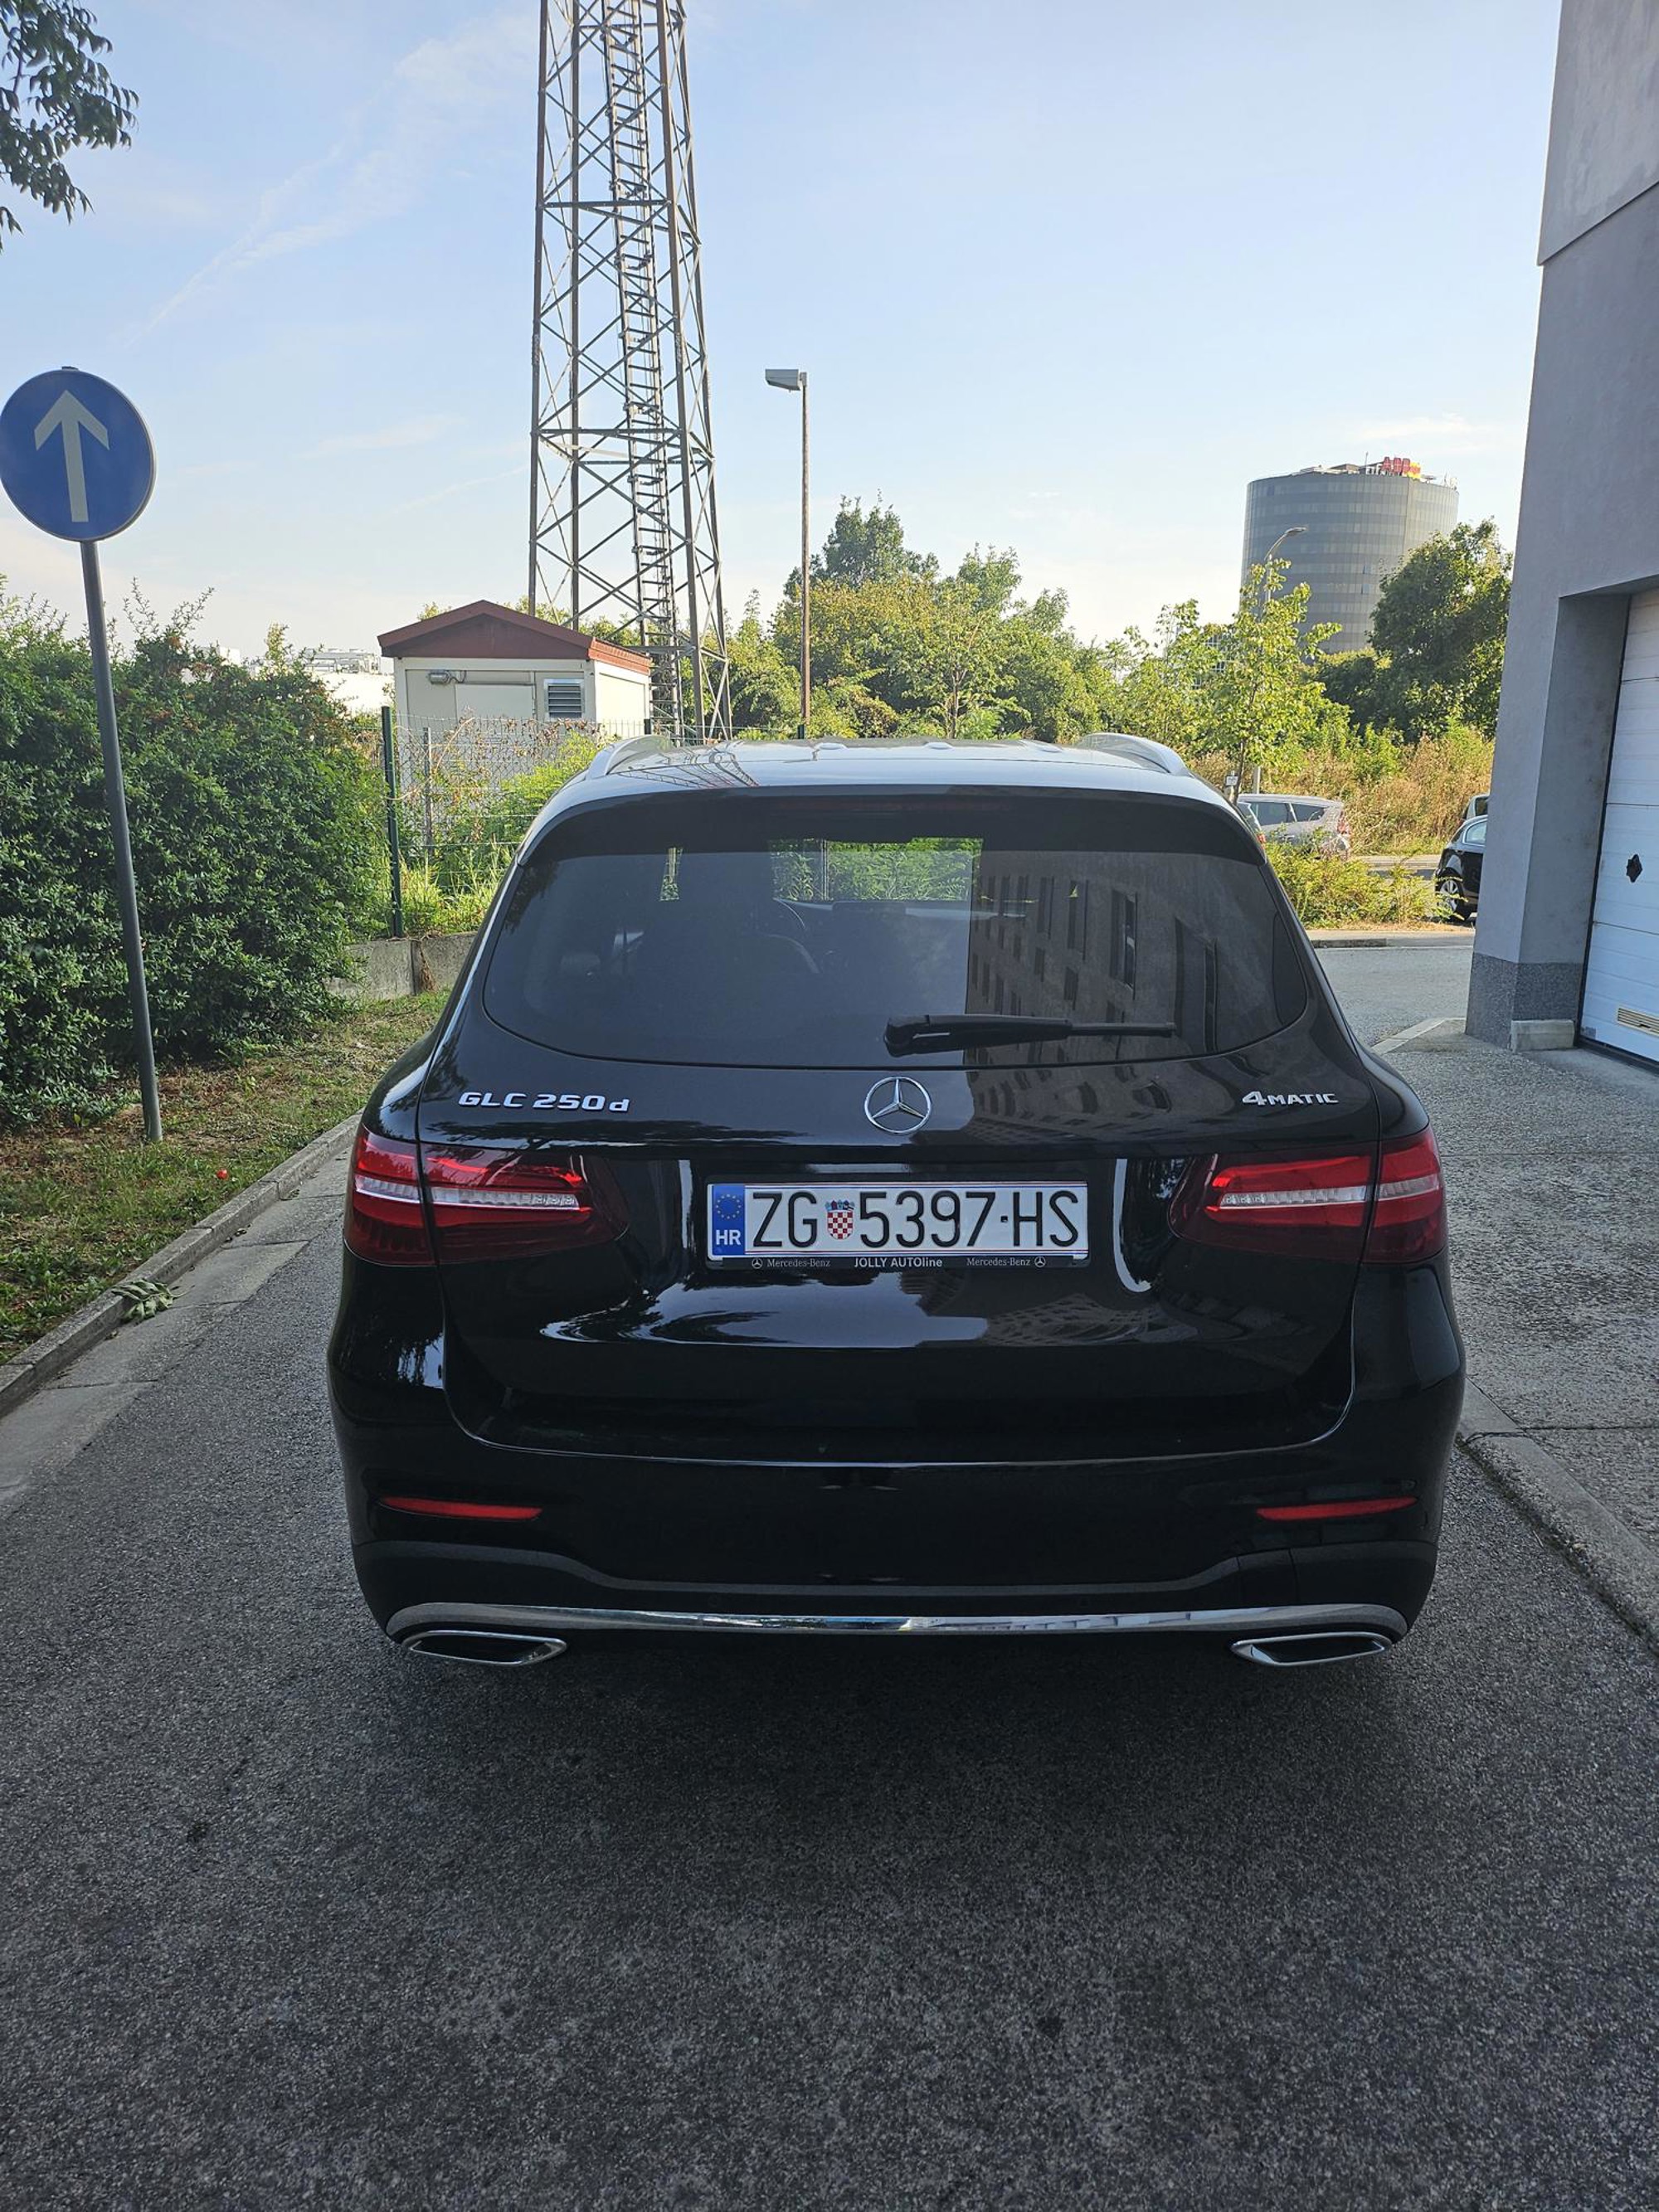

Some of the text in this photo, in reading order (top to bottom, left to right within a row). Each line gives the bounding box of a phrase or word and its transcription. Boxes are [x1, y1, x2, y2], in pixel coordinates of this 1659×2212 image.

[458, 1091, 527, 1108] GLC
[1243, 1091, 1340, 1106] 4MATIC
[752, 1191, 818, 1248] ZG
[716, 1229, 742, 1246] HR
[766, 1258, 830, 1267] Mercedes-Benz
[854, 1257, 943, 1267] JOLLY AUTOline
[966, 1257, 1031, 1266] Mercedes-Benz
